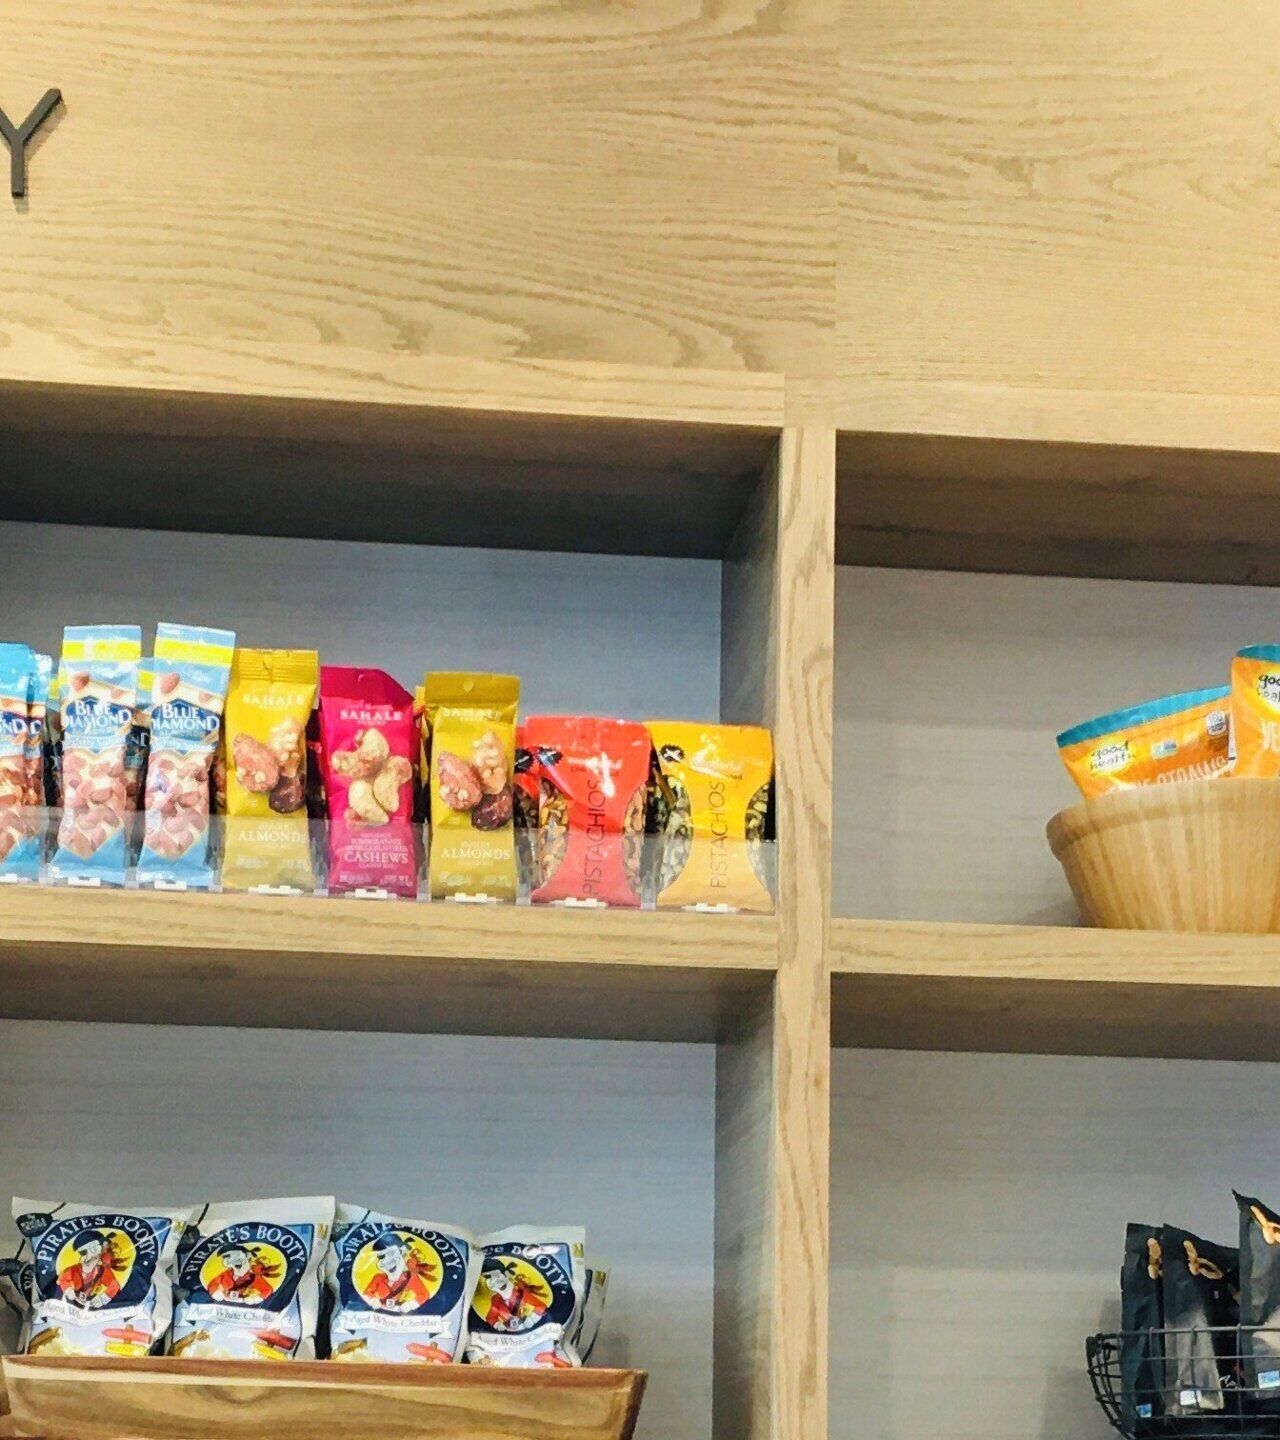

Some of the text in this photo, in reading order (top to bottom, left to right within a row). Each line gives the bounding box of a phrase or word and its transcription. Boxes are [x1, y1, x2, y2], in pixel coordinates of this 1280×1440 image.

[344, 851, 409, 864] CASHEWS
[441, 848, 511, 860] ALMONDS
[708, 781, 728, 889] PISTACHIOS
[37, 1214, 107, 1263] PIRATE'S
[187, 1225, 306, 1274] PIRATE'S BOOTY
